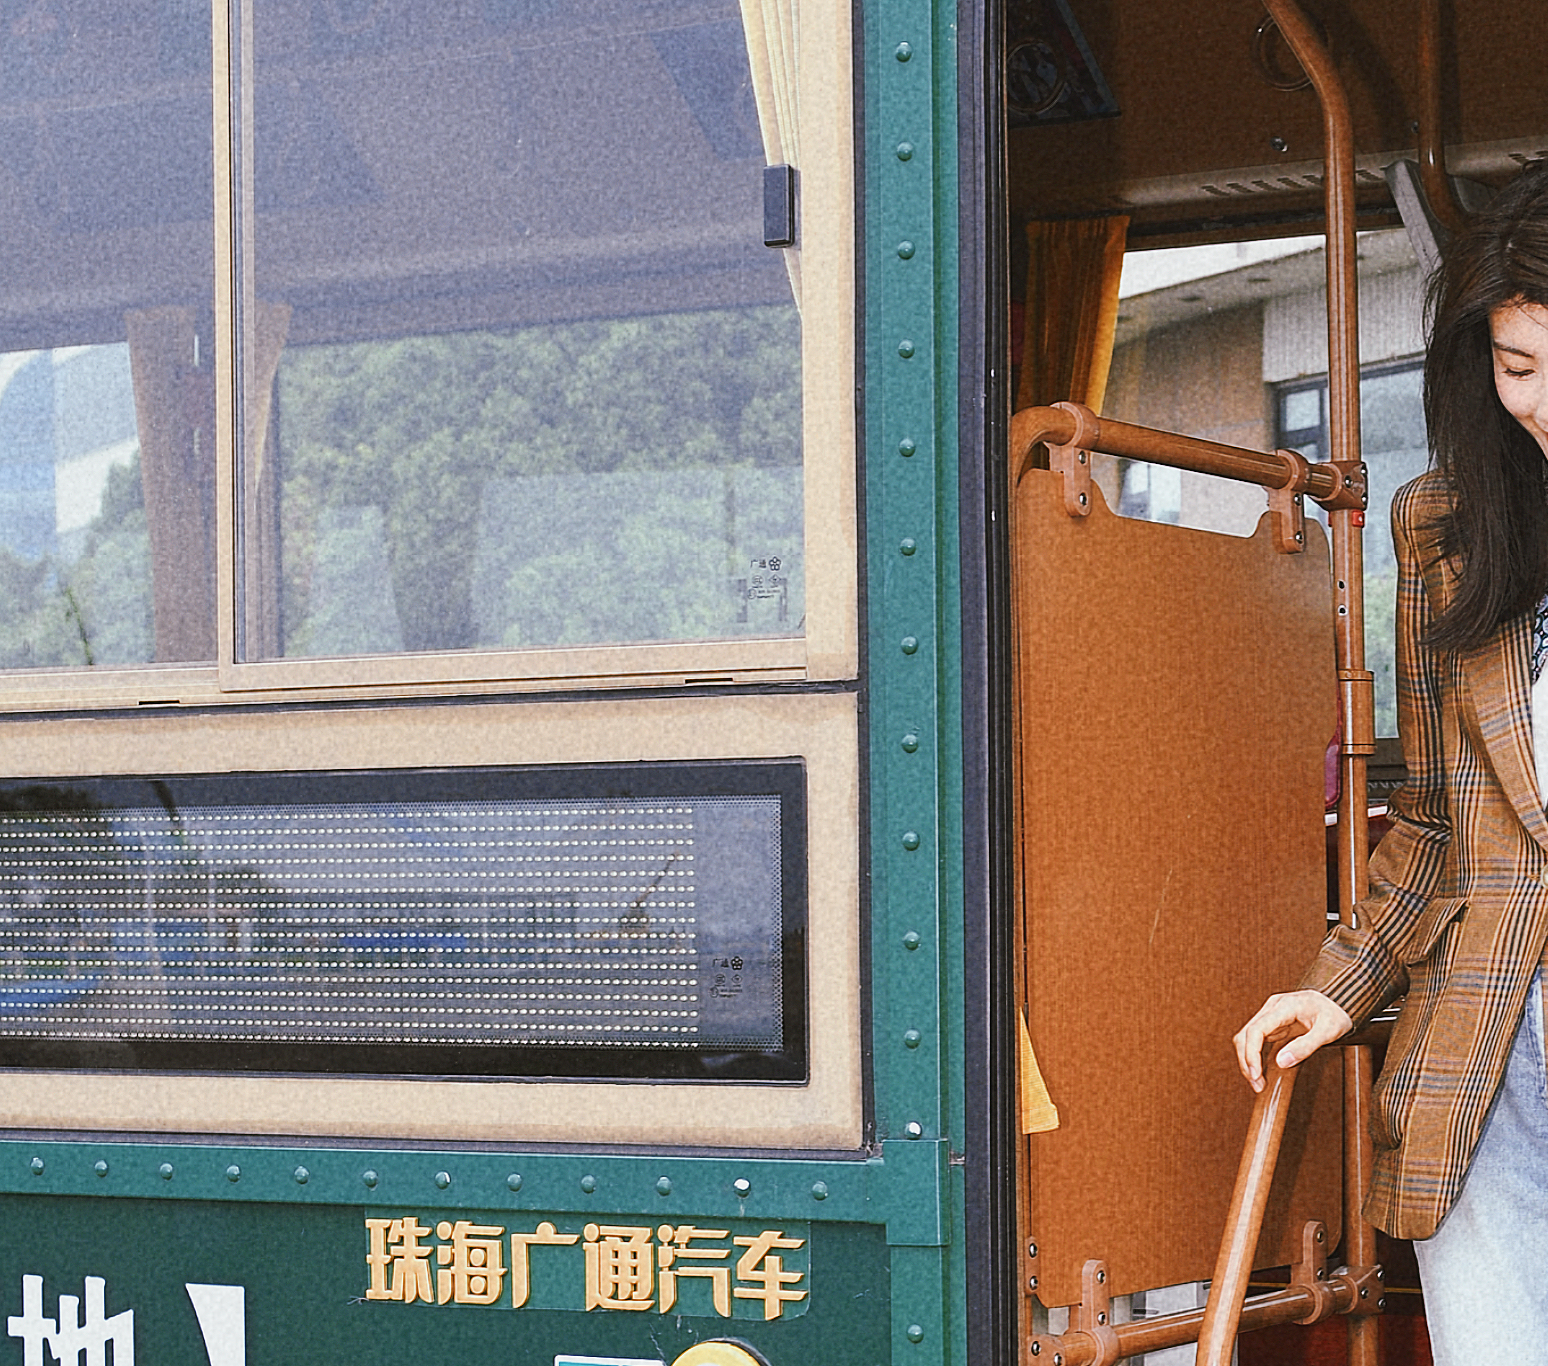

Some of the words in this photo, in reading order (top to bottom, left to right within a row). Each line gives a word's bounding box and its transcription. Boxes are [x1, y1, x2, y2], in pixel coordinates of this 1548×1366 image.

[365, 1216, 807, 1320] 珠海广通汽车
